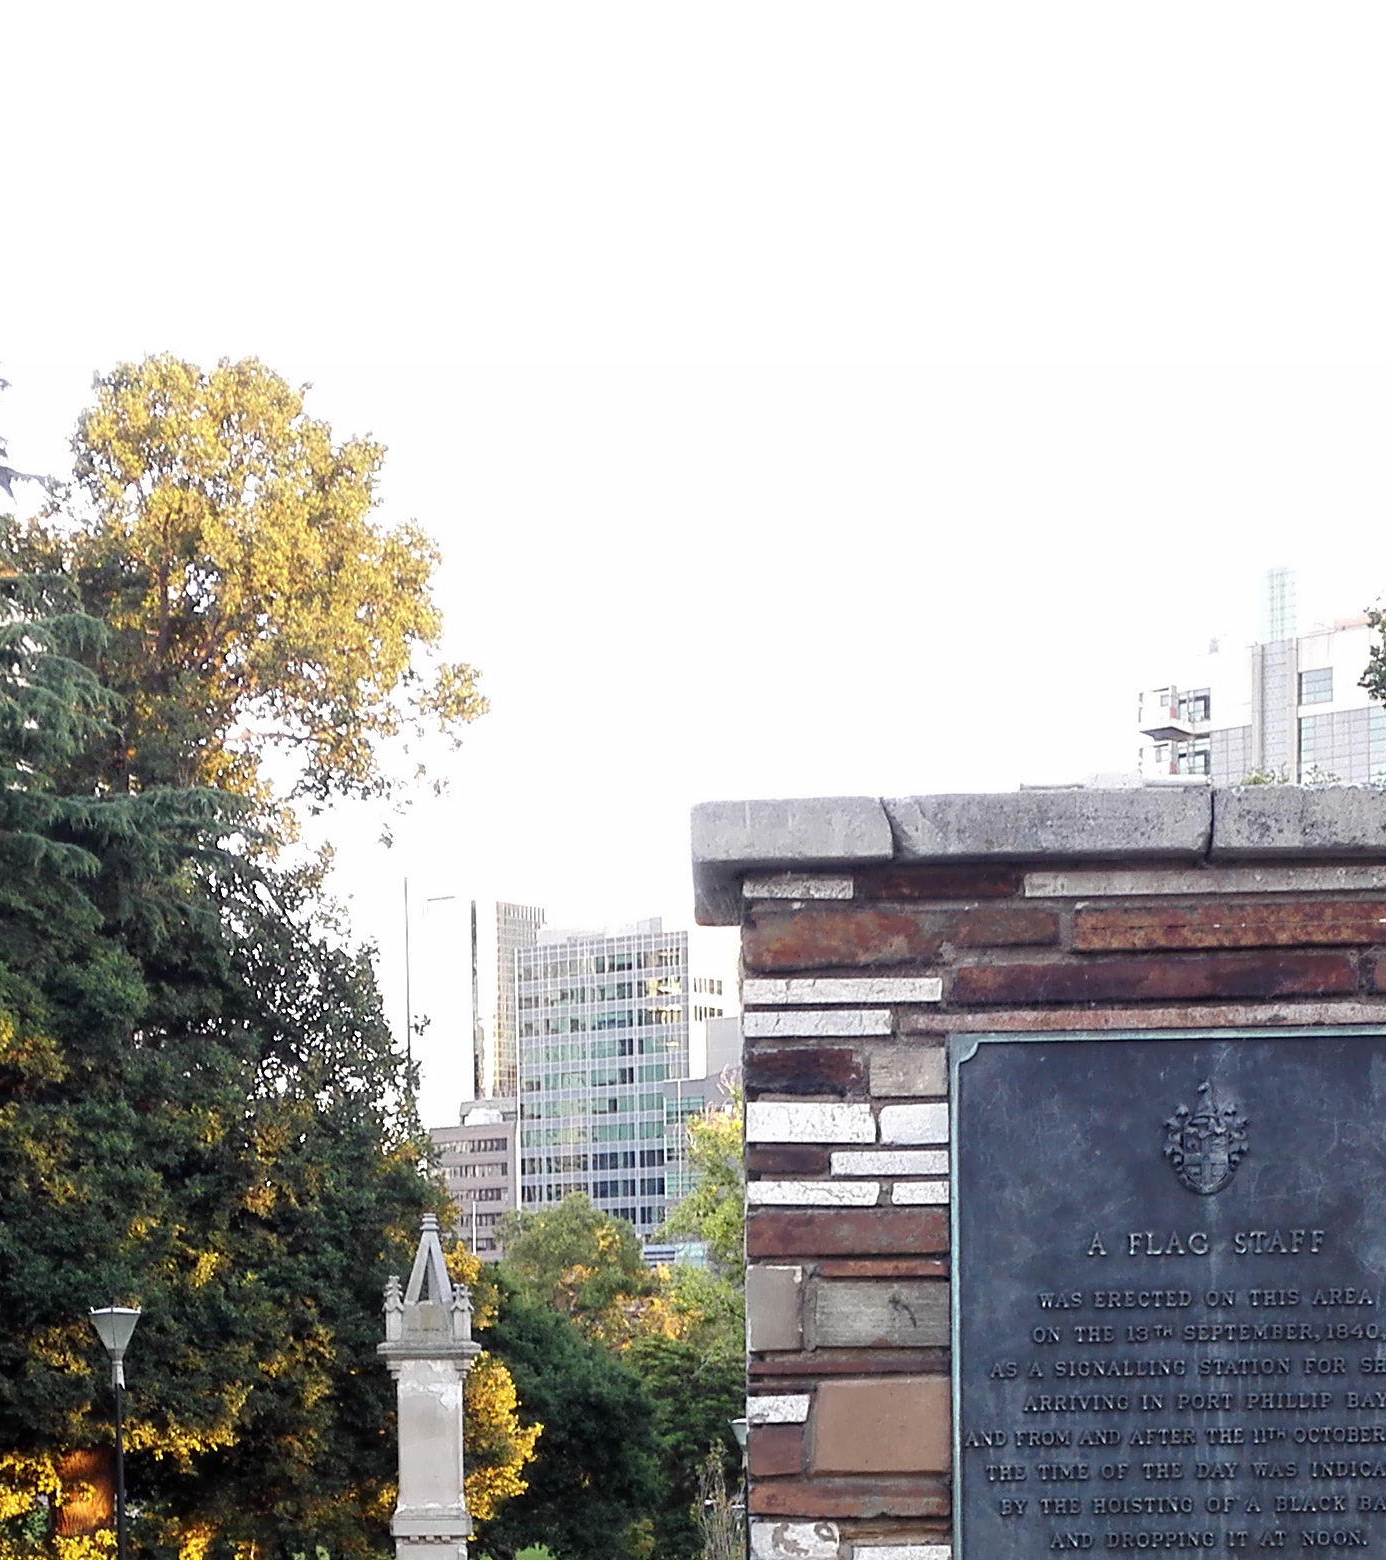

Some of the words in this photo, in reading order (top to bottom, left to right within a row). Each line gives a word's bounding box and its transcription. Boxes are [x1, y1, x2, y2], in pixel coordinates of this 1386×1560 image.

[1087, 1232, 1107, 1256] A
[1128, 1231, 1208, 1256] FLAG
[1234, 1229, 1325, 1254] STAFF
[1039, 1292, 1082, 1308] WAS
[1094, 1291, 1192, 1308] ERECTED
[1206, 1290, 1235, 1306] ON
[1250, 1289, 1300, 1306] THIS
[1312, 1288, 1374, 1305] AREA
[1033, 1326, 1061, 1343] ON
[1075, 1326, 1114, 1342] THE
[990, 1361, 1017, 1378] AS
[1028, 1361, 1043, 1378] A
[1055, 1360, 1186, 1377] SIGNALLING
[1198, 1359, 1291, 1375] STATION
[1304, 1358, 1346, 1374] FOR
[1023, 1394, 1129, 1412] ARRIVING
[1142, 1394, 1163, 1410] IN
[1178, 1393, 1233, 1410] PORT
[1247, 1392, 1332, 1409] PHILLIP
[965, 1430, 1007, 1447] AND
[1015, 1430, 1071, 1447] FROM
[1079, 1429, 1121, 1446] AND
[1129, 1428, 1197, 1445] AFTER
[1206, 1428, 1244, 1444] THE
[986, 1464, 1026, 1482] THE
[1038, 1464, 1089, 1481] TIME
[1101, 1463, 1129, 1479] OF
[1142, 1462, 1183, 1479] THE
[1196, 1462, 1237, 1478] DAY
[1252, 1461, 1298, 1478] WAS
[999, 1498, 1028, 1515] BY
[1040, 1498, 1081, 1514] THE
[1093, 1497, 1194, 1514] HOISTING
[1206, 1497, 1235, 1513] OF
[1246, 1496, 1261, 1513] A
[1276, 1496, 1346, 1512] BLACK
[1050, 1532, 1094, 1549] AND
[1107, 1531, 1214, 1548] DROPPING
[1227, 1531, 1248, 1547] IT
[1260, 1530, 1286, 1547] AT
